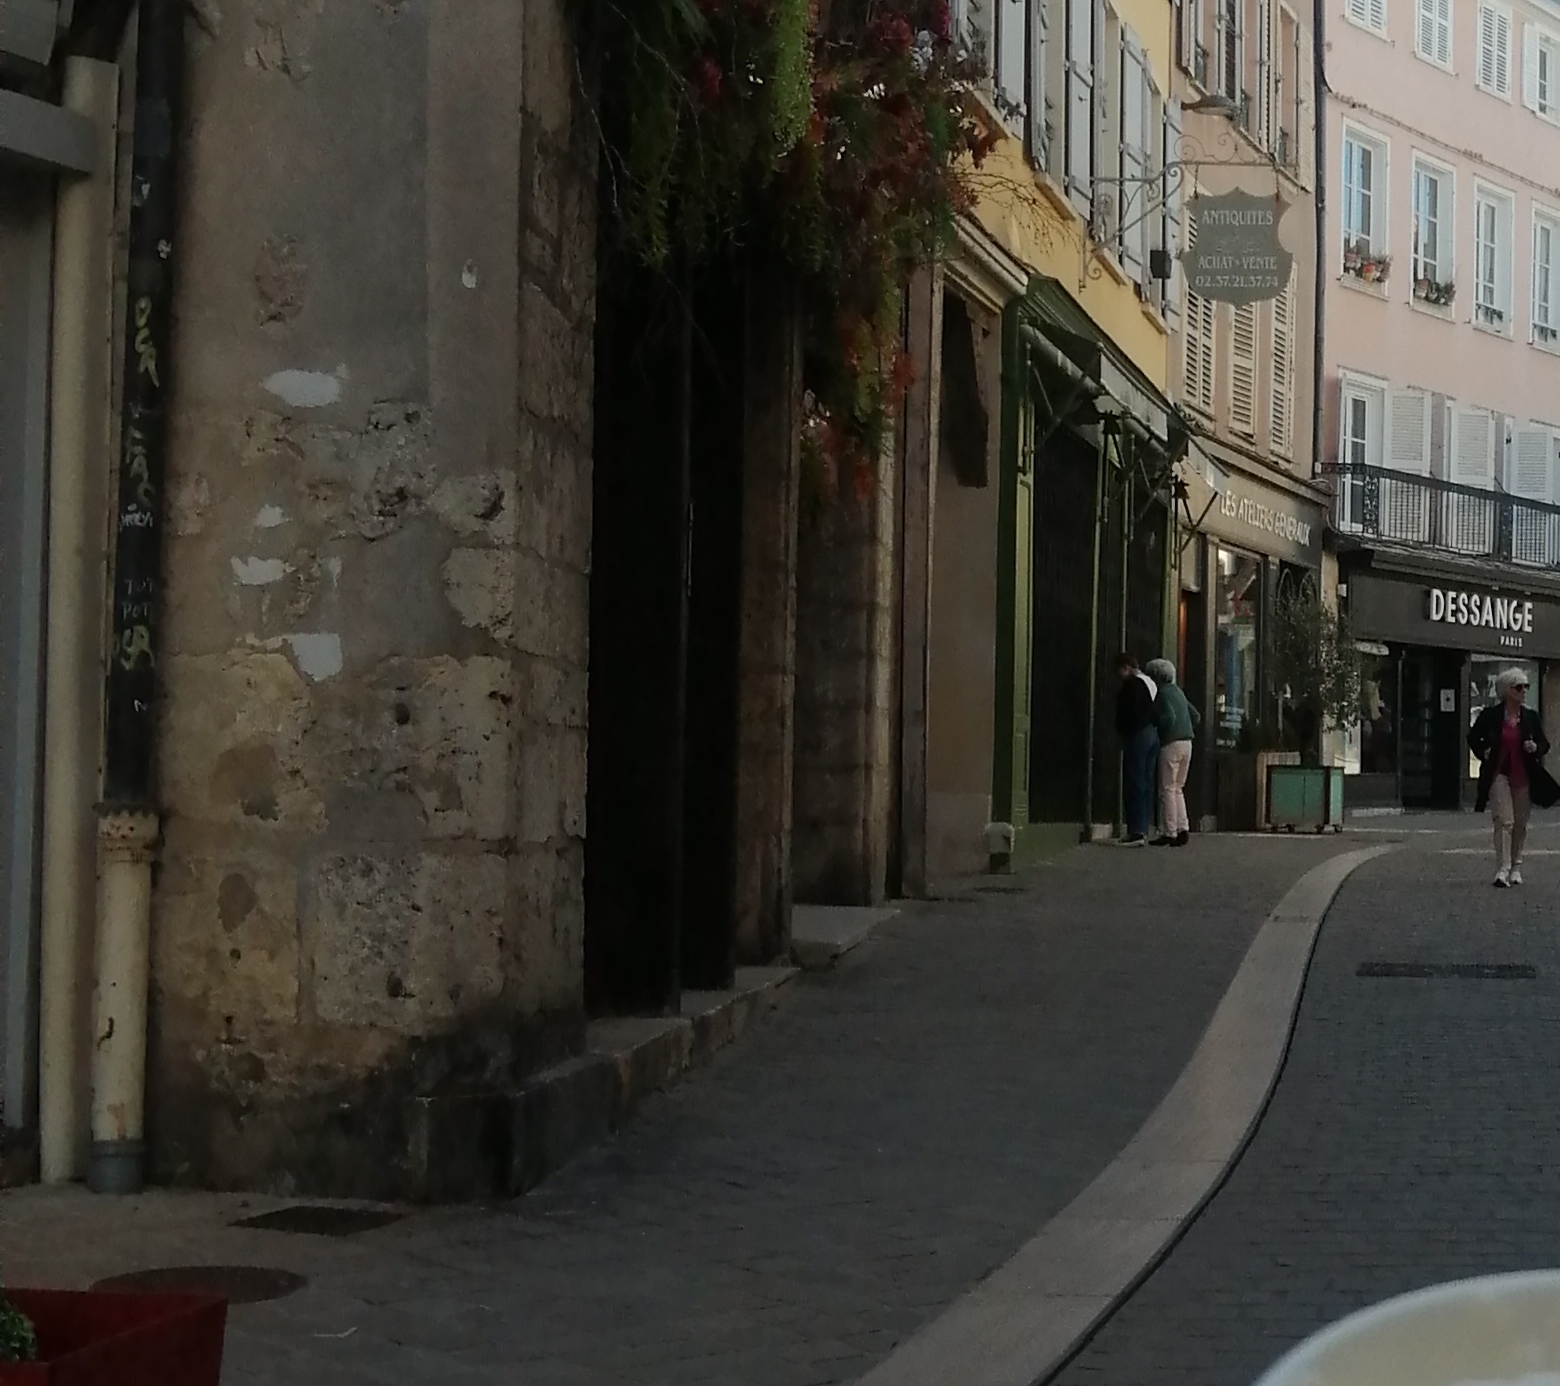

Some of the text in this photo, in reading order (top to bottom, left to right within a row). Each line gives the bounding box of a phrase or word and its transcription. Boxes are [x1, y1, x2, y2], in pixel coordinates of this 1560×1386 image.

[1198, 256, 1233, 269] ACHAT
[1242, 256, 1278, 270] VENTE
[1195, 275, 1279, 288] 02.37.21.37.74
[1220, 490, 1237, 518] LES
[1430, 588, 1534, 633] DESSANGE
[1500, 635, 1524, 648] PARIS
